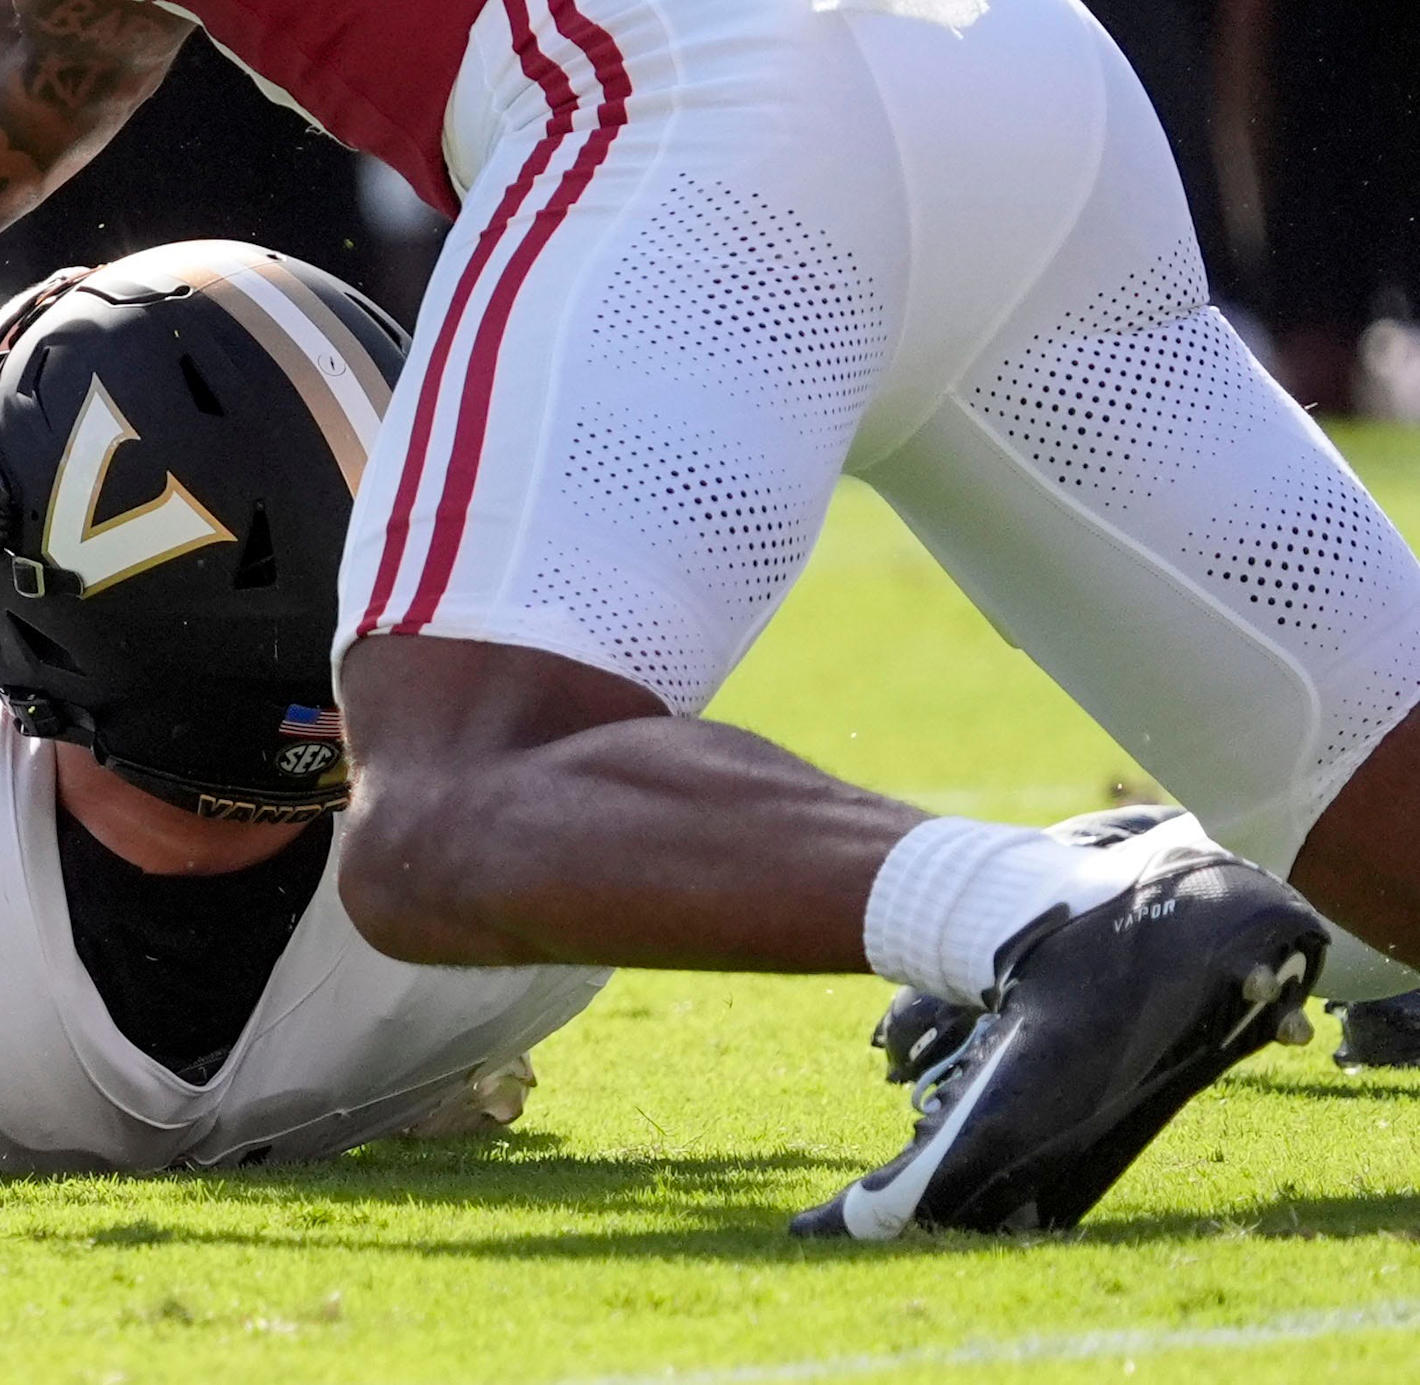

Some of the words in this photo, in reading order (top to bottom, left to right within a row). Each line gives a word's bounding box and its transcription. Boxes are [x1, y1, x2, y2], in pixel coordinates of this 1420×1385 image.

[41, 371, 237, 600] V
[279, 743, 333, 774] SEC
[1113, 898, 1177, 933] VAPOR
